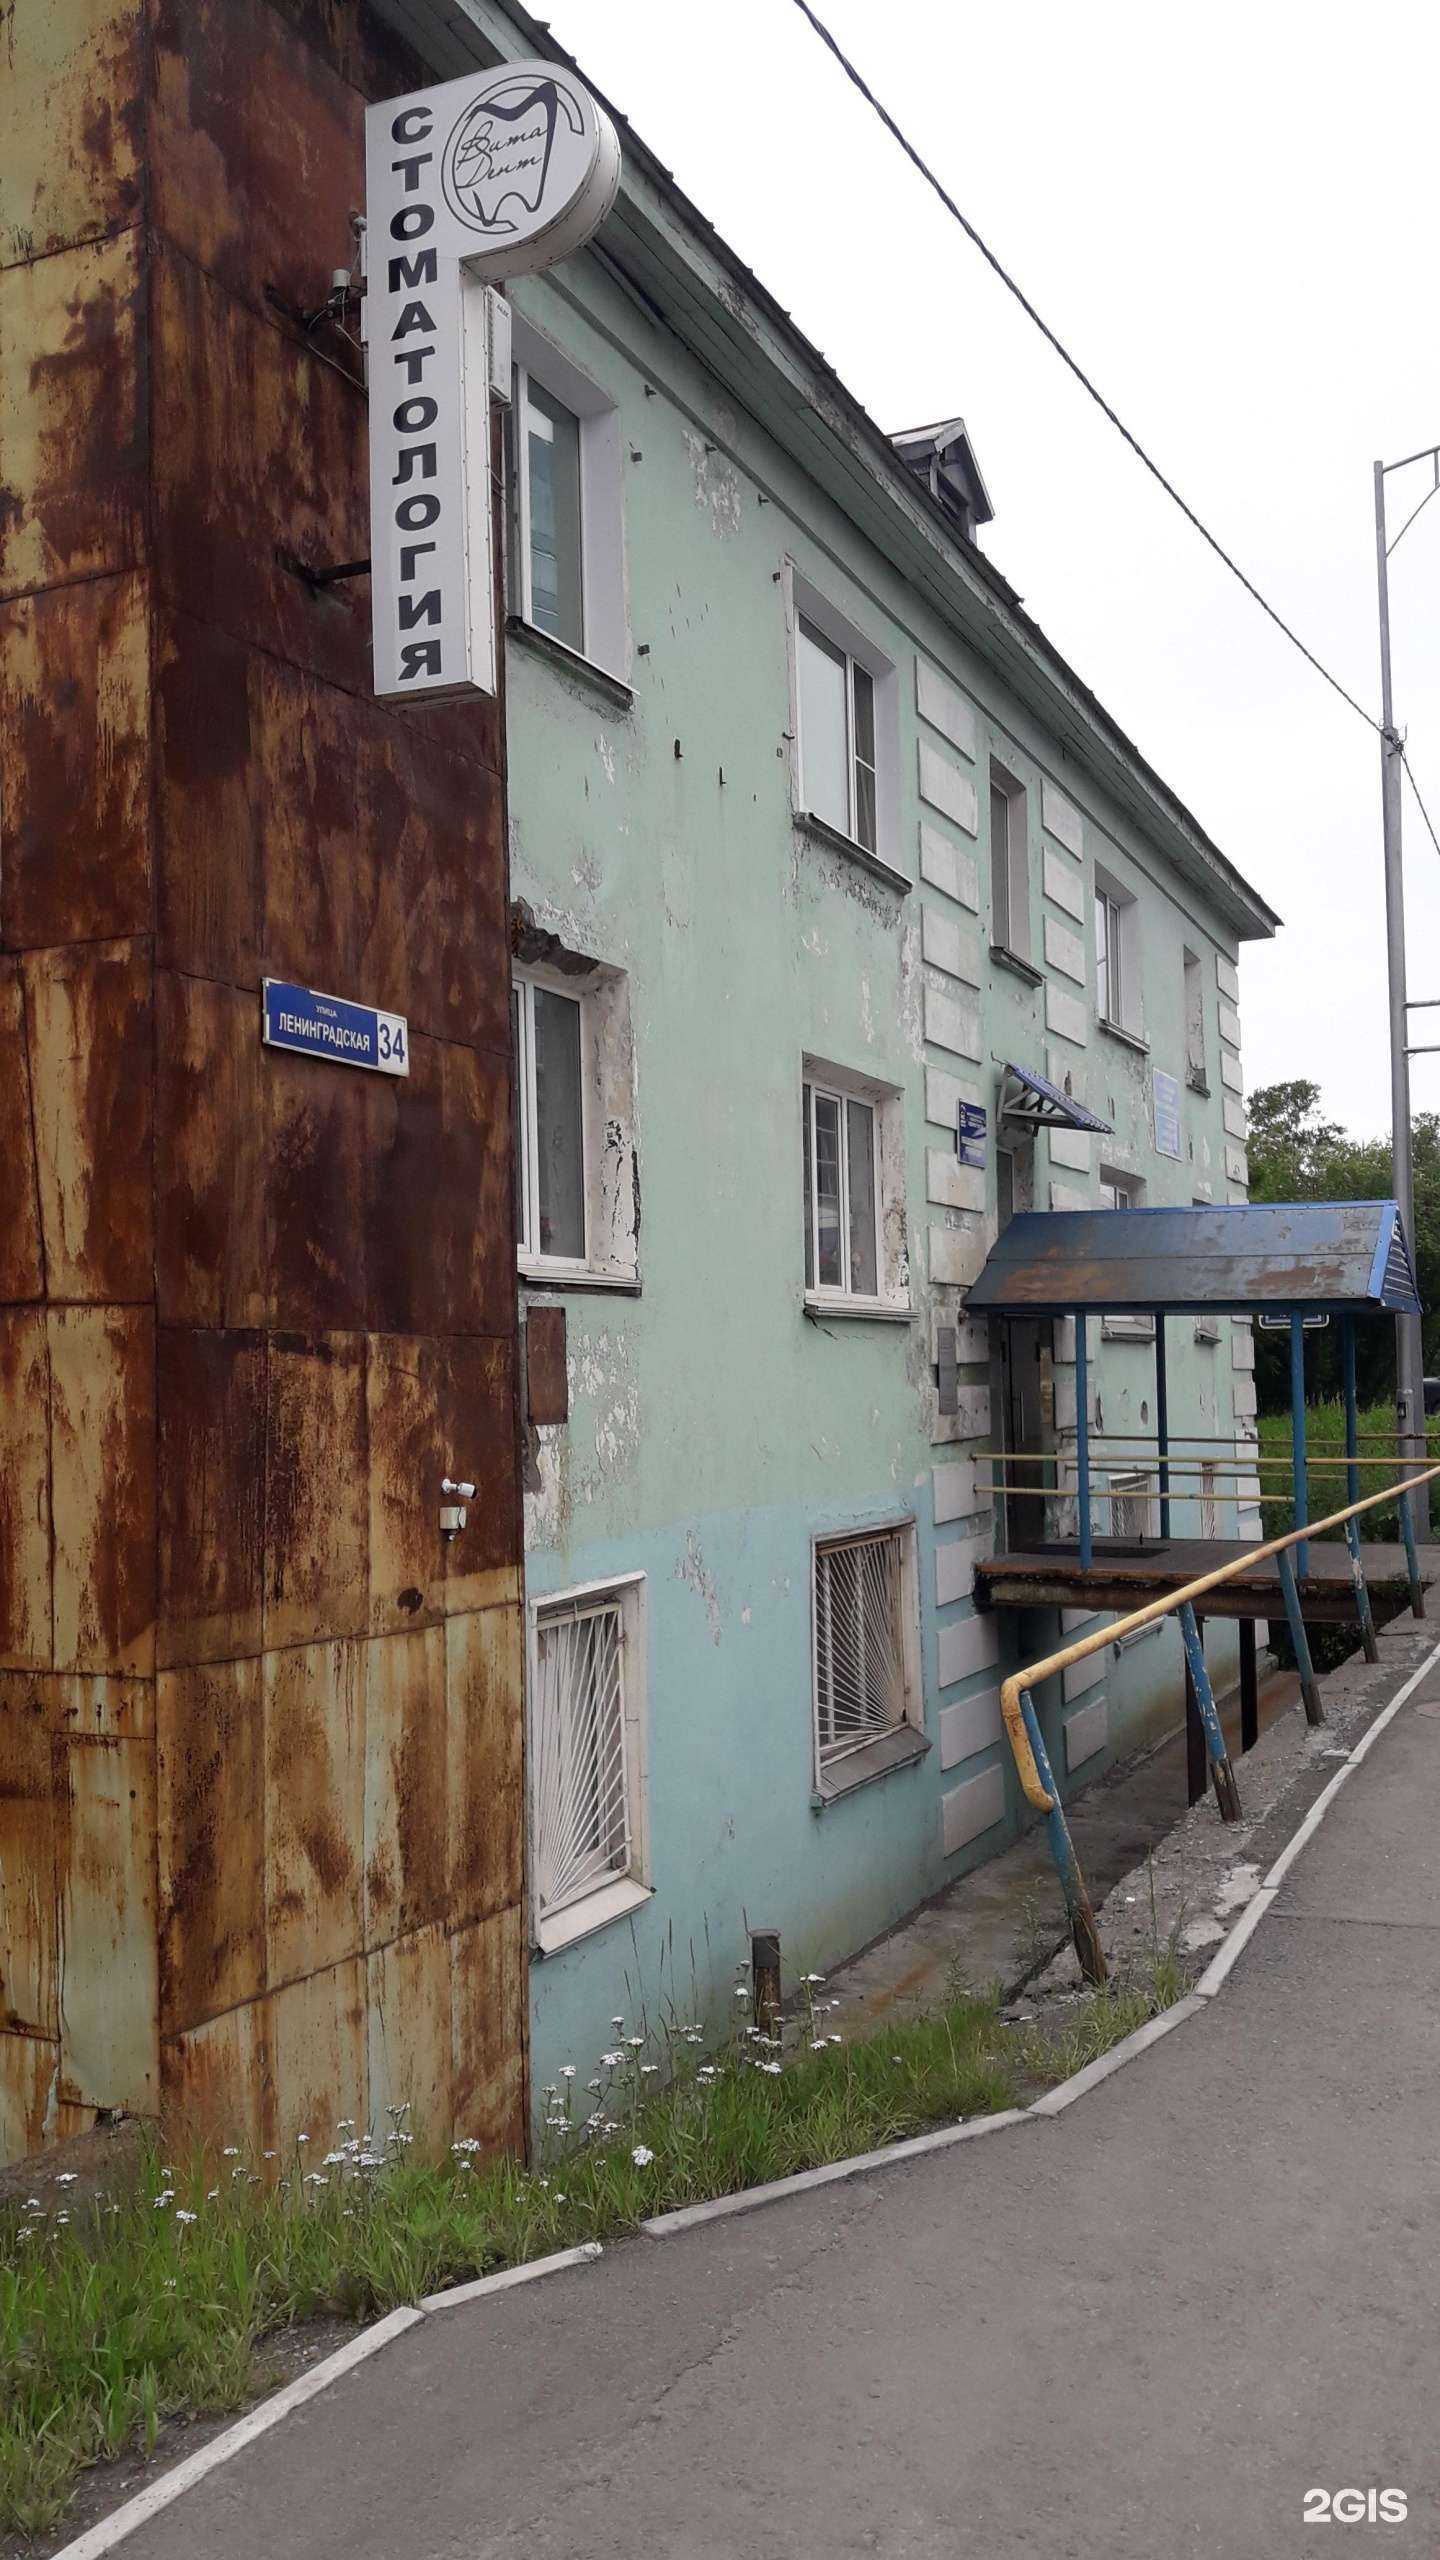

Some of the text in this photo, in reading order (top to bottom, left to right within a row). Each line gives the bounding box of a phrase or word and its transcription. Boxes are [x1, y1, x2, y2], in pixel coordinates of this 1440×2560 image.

[456, 120, 547, 170] Вита
[456, 152, 542, 188] Дент
[388, 106, 443, 682] СТОМАТОЛОГИЯ
[315, 1004, 338, 1018] УЛИЦА
[279, 1012, 405, 1063] ЛЕНИНГРАДСКАЯ 34
